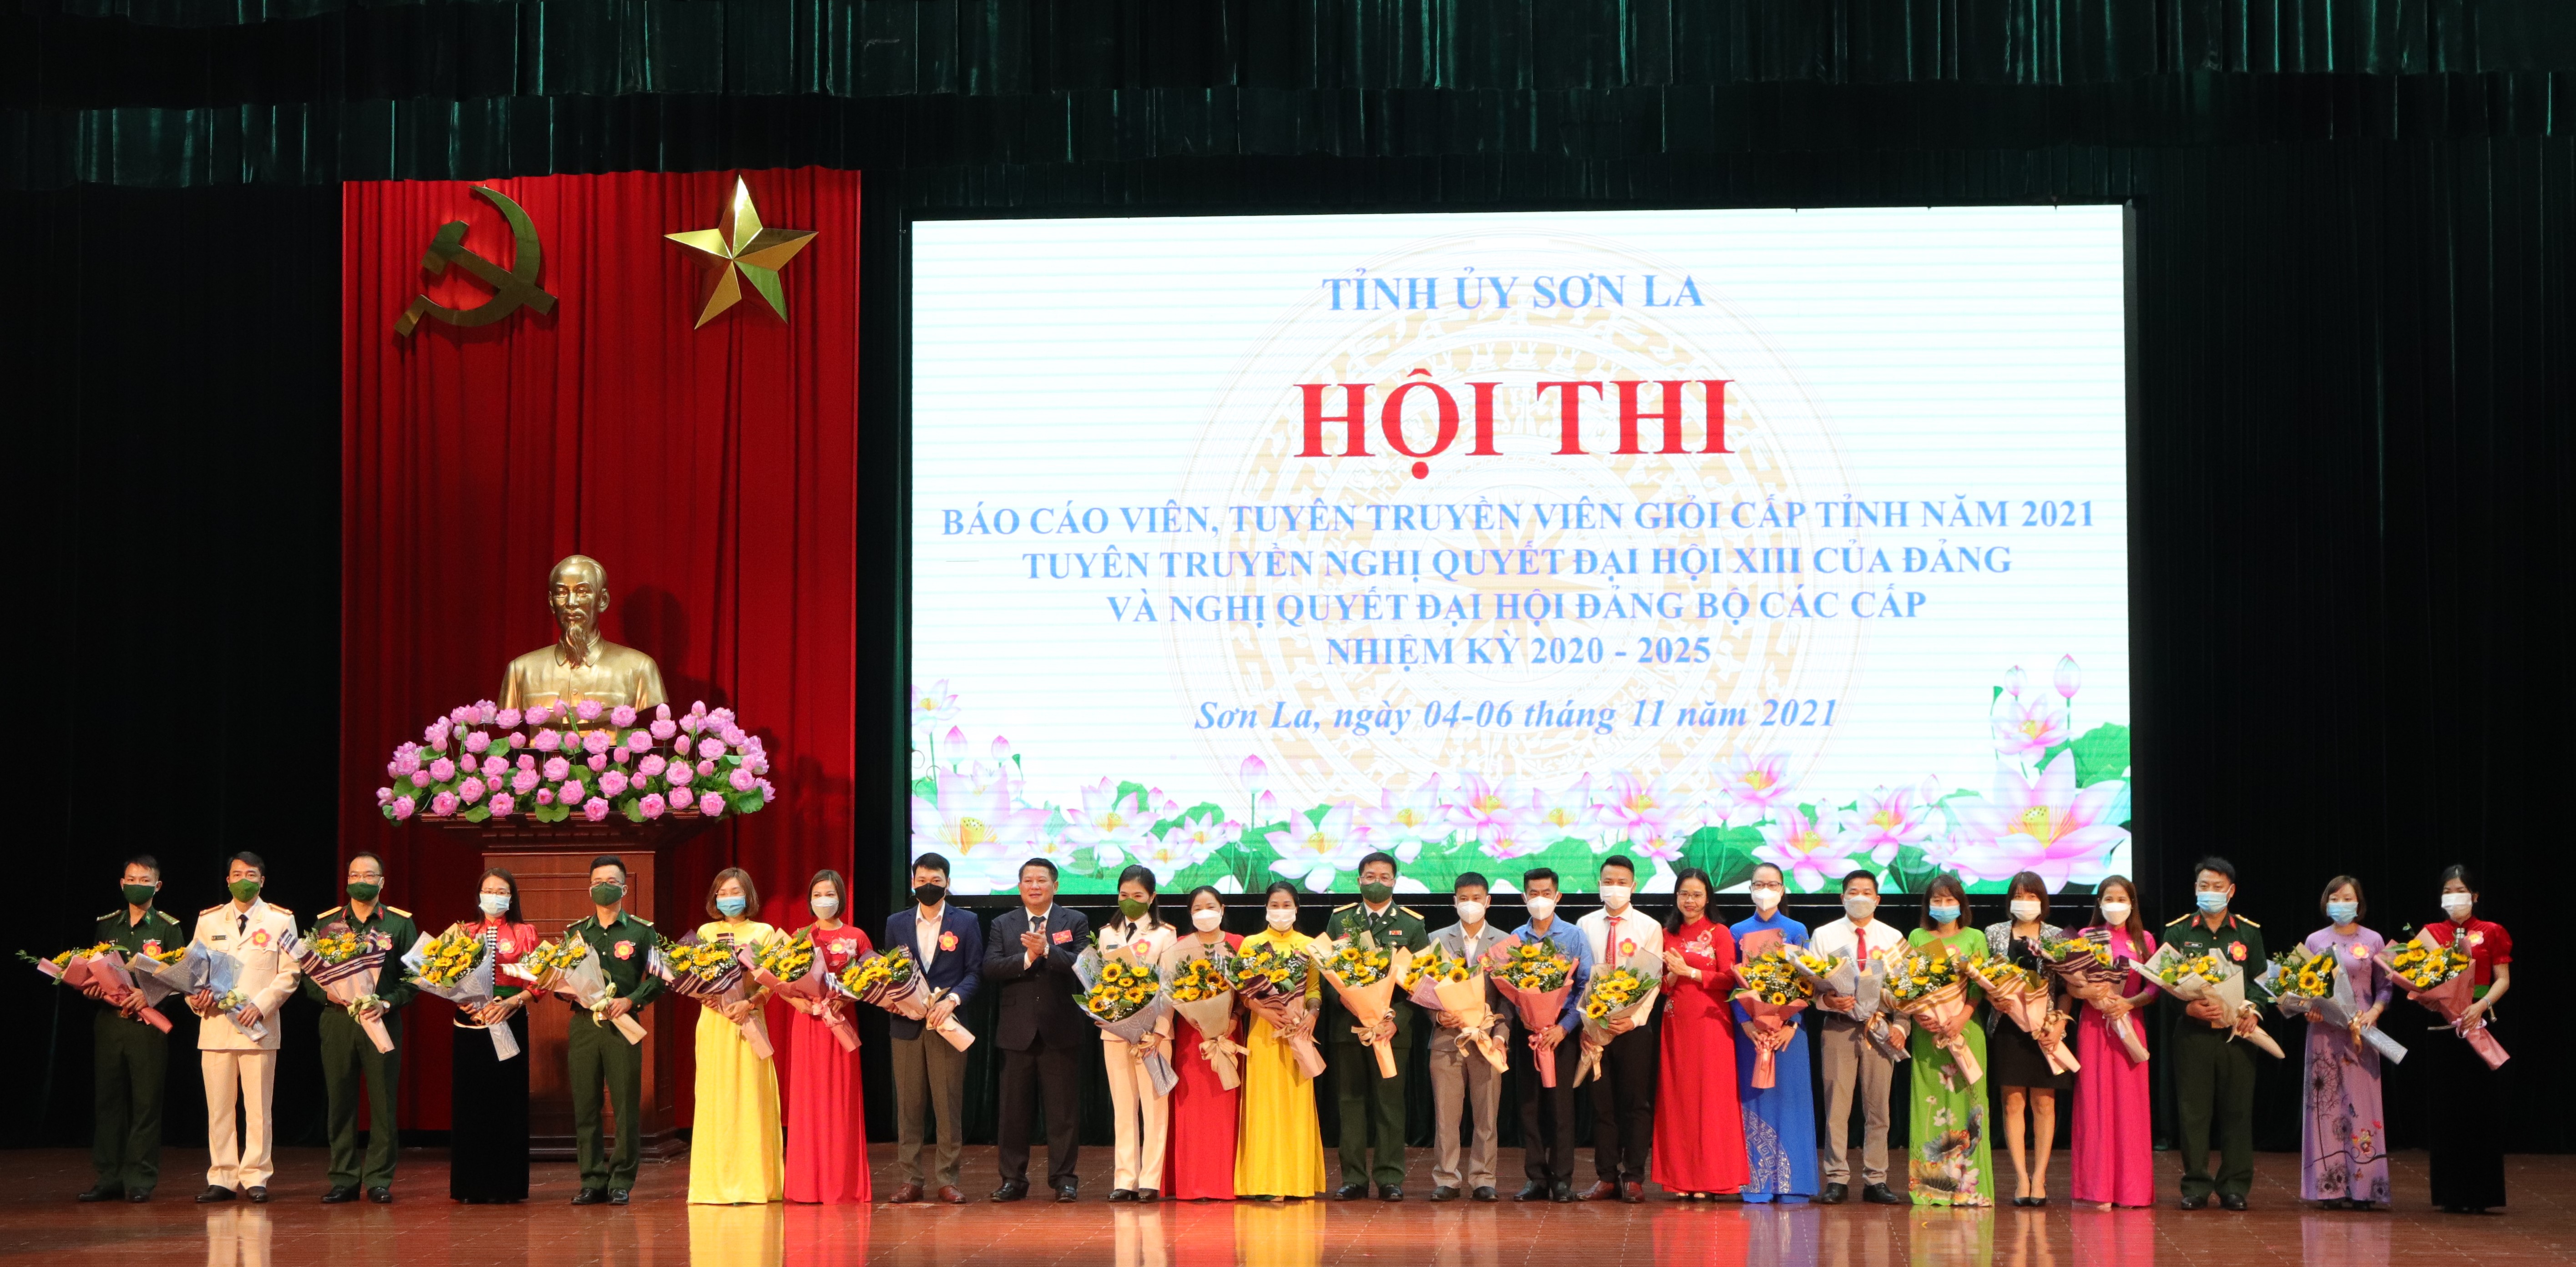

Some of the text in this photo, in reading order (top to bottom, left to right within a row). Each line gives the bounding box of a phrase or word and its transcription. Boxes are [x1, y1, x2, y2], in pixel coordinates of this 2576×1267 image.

[1321, 266, 1704, 311] TỈNH ỦY SƠN LA
[1293, 368, 1735, 480] HỘI THI
[942, 493, 2092, 535] BÁO CÁO VIÊN, TUYÊN TRUYỀN VIÊN GIỎI CẤP TỈNH NĂM 2021
[1022, 538, 2011, 583] TUYÊN TRUYỀN NGHỊ QUYẾT ĐẠI HỘI XIII CỦA ĐẢNG
[1106, 583, 1926, 629] VÀ NGHỊ QUYẾT ĐẠI HỘI ĐẢNG BỘ CÁC CẤP
[1326, 634, 1453, 672] NHIỆM
[1466, 629, 1520, 665] KỲ
[1531, 636, 1604, 665] 2020
[1637, 636, 1711, 664] 2025
[1194, 698, 1836, 736] Sơn La, ngày 04-06 tháng 11 năm 2021
